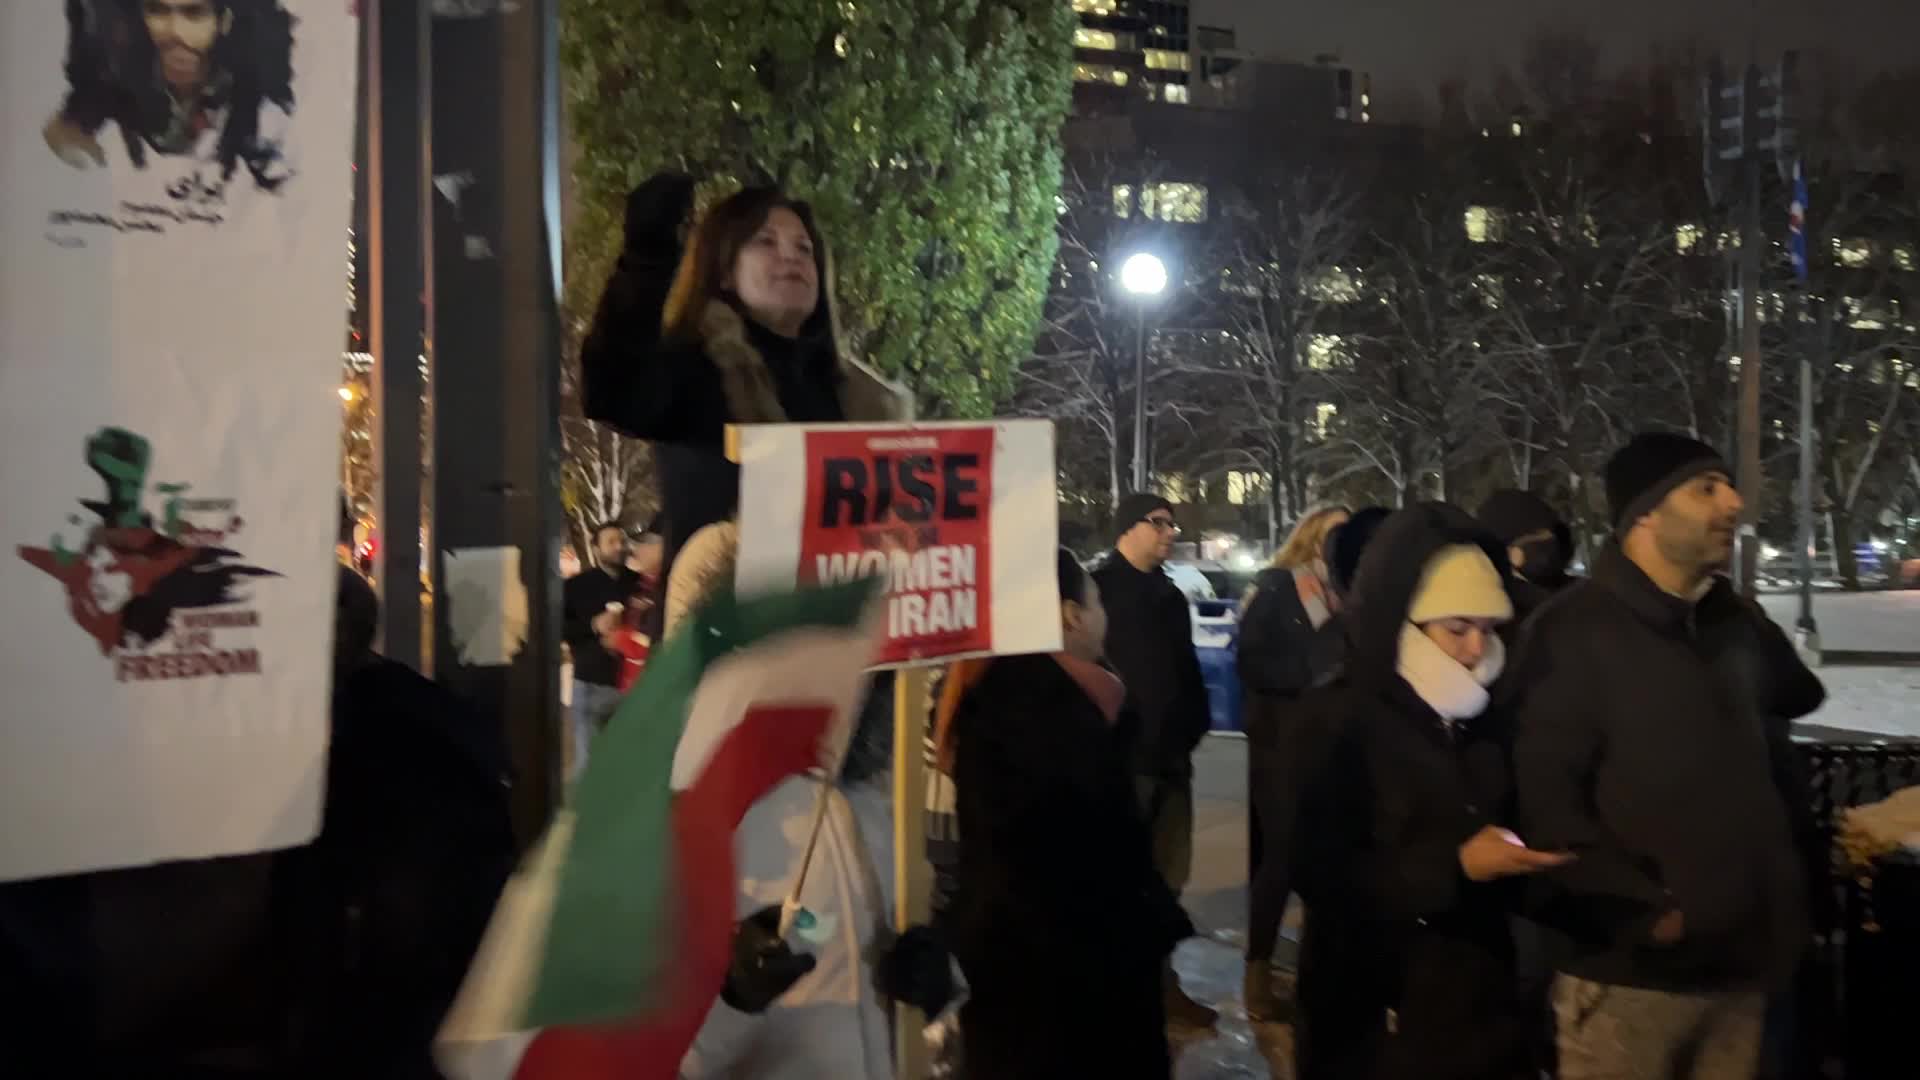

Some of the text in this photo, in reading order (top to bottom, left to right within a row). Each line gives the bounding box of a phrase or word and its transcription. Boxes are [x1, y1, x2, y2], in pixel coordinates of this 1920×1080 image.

[818, 452, 978, 528] RISE
[887, 587, 977, 638] IRAN
[115, 648, 261, 682] FREEDOM
